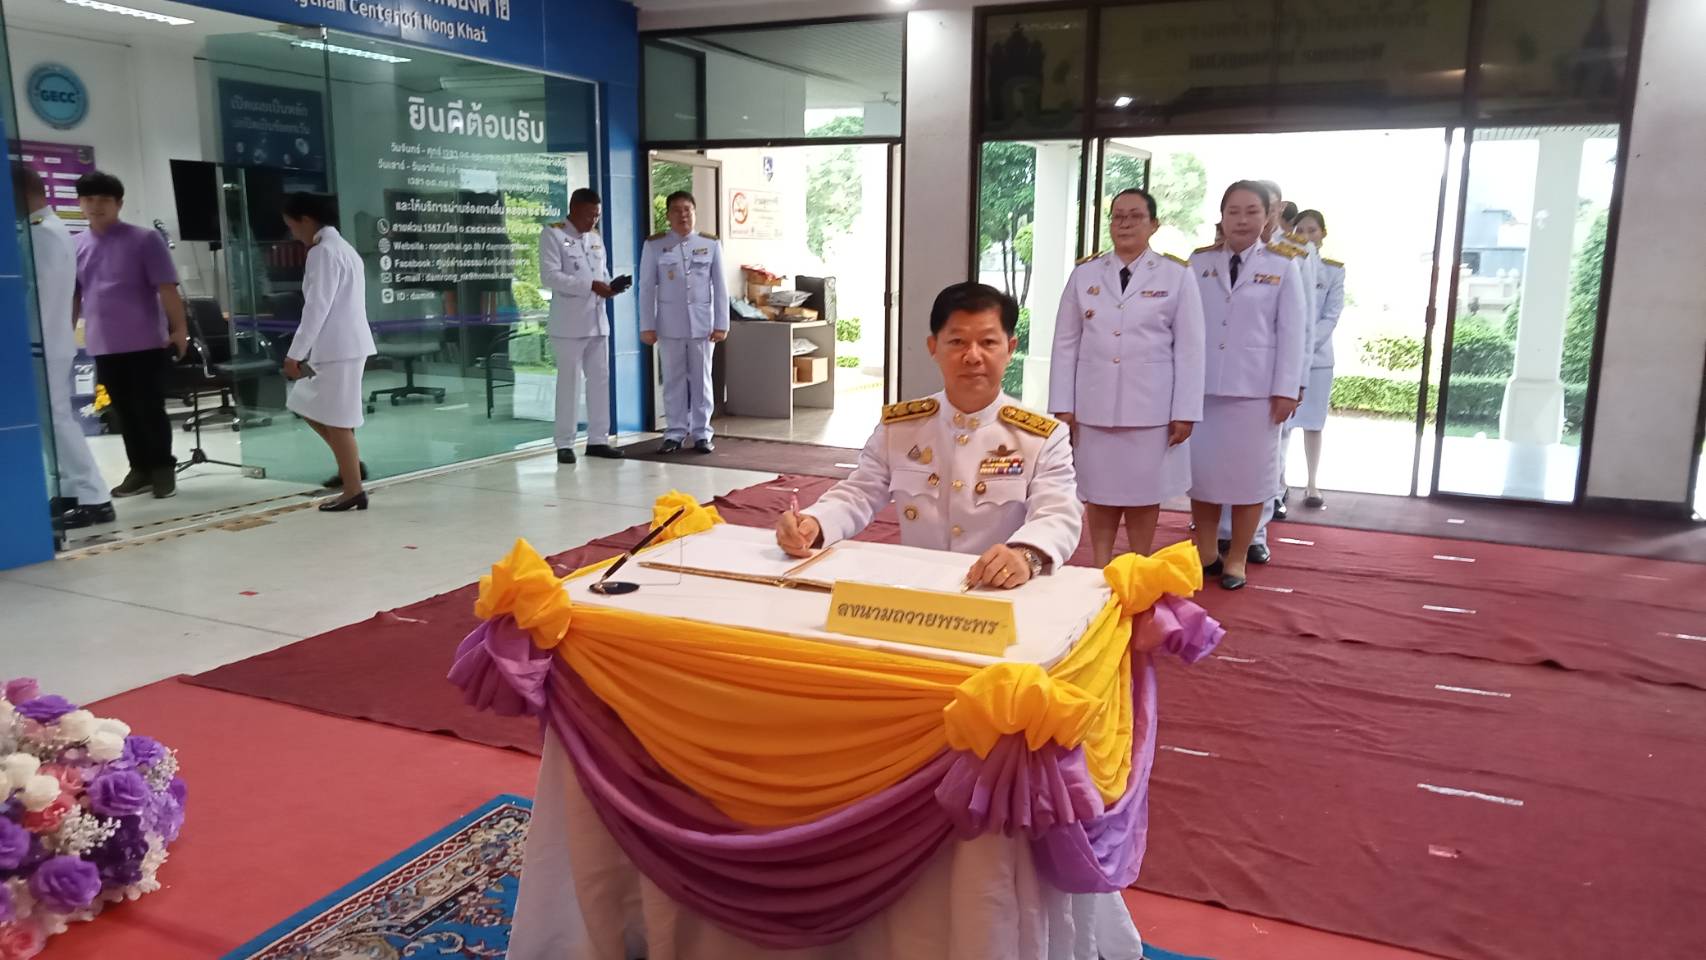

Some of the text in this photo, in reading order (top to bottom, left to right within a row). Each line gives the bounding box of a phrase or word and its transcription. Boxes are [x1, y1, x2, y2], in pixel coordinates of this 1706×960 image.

[349, 0, 399, 26] Center
[401, 11, 420, 30] of
[422, 14, 455, 39] Nong
[457, 21, 488, 43] Khai
[40, 89, 76, 104] GECC
[408, 96, 544, 144] ยินดีต้อนรับ
[837, 602, 999, 635] ลงนามถวายพระพร
